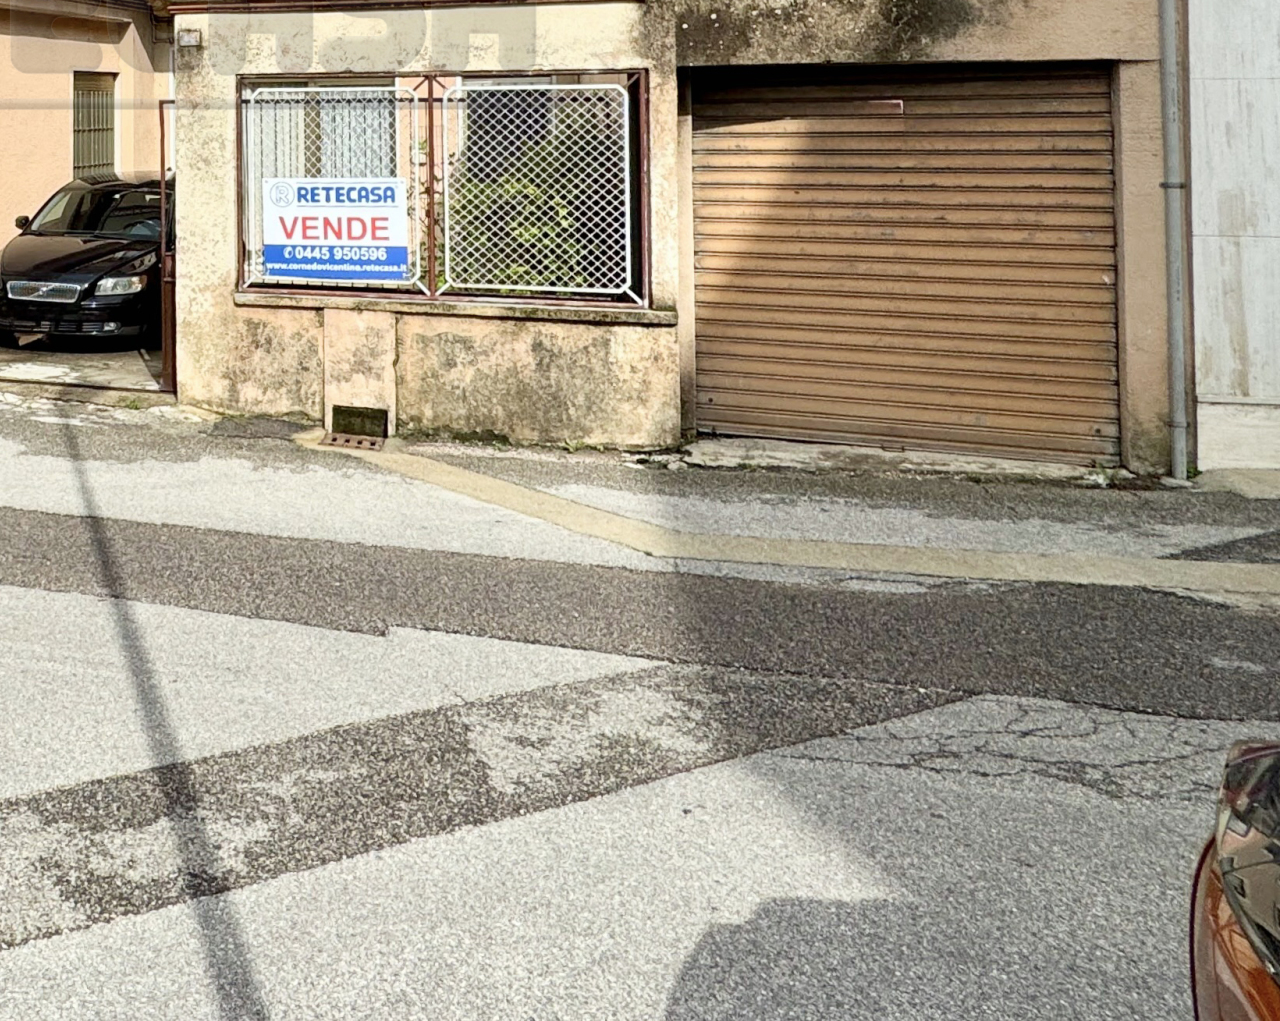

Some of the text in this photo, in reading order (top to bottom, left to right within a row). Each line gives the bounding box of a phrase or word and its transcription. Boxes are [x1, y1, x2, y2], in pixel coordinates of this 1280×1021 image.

[296, 186, 396, 204] RETECASA
[278, 216, 390, 241] VENDE
[295, 246, 387, 261] 0445 950596
